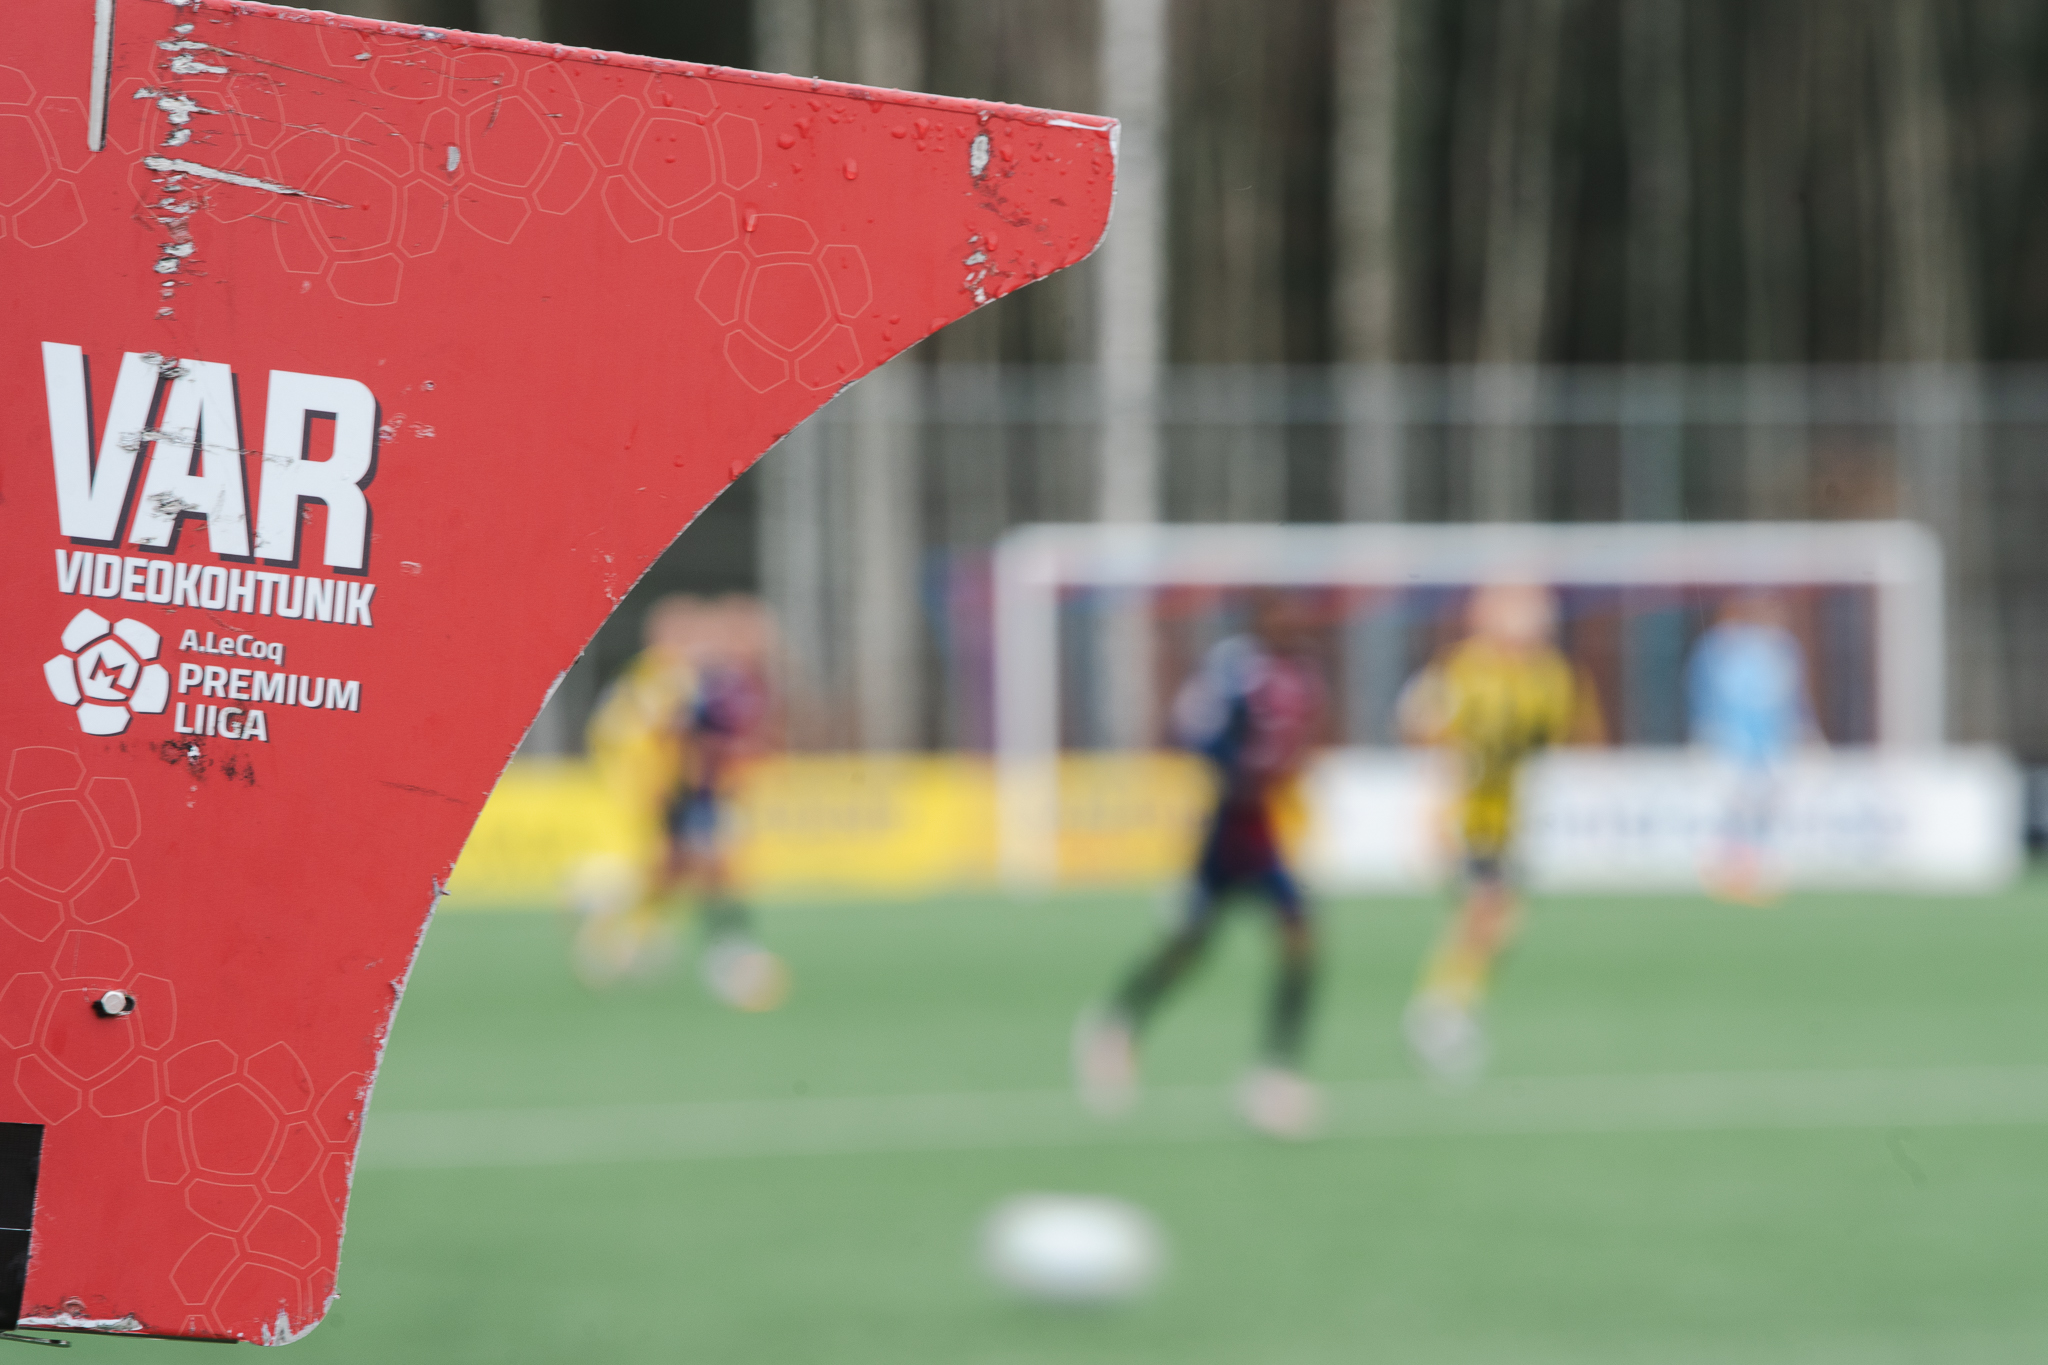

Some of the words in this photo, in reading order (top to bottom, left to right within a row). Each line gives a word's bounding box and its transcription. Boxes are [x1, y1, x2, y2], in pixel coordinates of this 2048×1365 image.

[41, 341, 382, 577] VAR
[55, 549, 376, 627] VIDEOKOHTUNIK
[177, 663, 361, 712] PREMIUM
[174, 702, 269, 742] LIIGA
